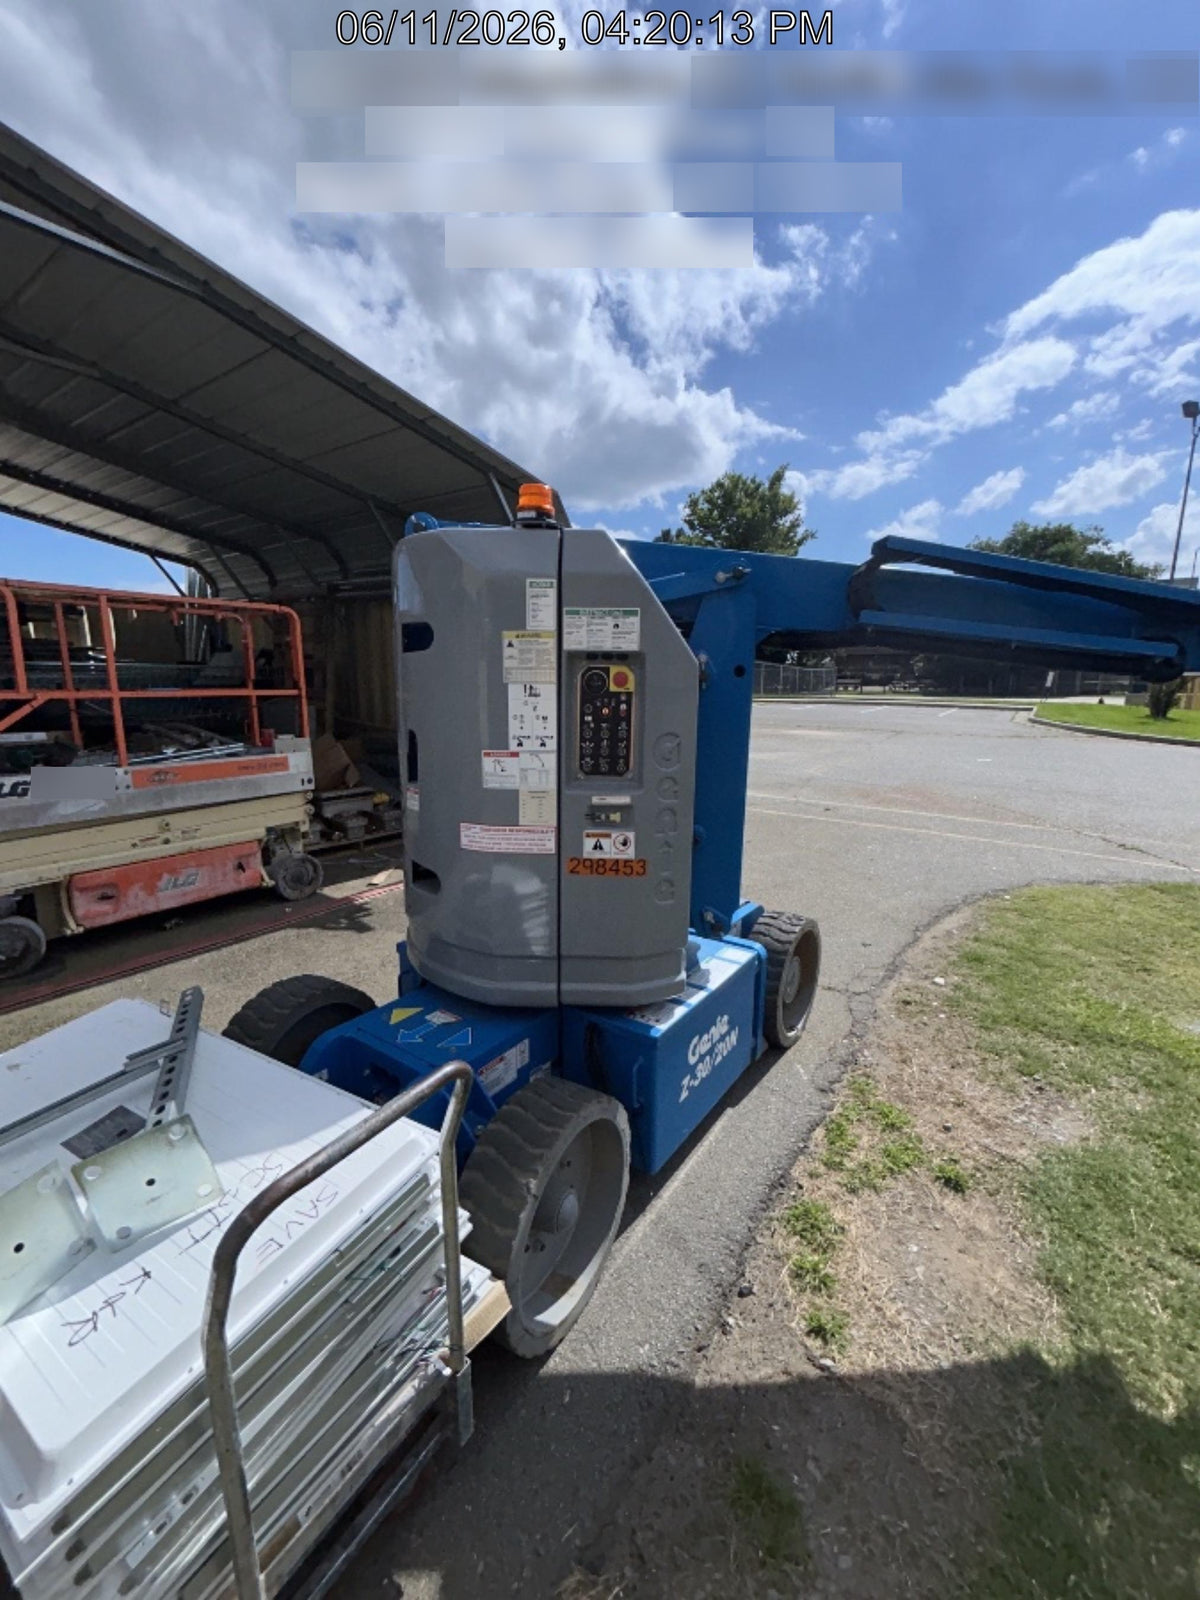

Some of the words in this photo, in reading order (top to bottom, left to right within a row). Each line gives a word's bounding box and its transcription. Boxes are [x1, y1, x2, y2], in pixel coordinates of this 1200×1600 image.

[568, 857, 647, 876] 298453
[687, 1014, 729, 1066] Genie
[254, 1183, 339, 1268] SAVE
